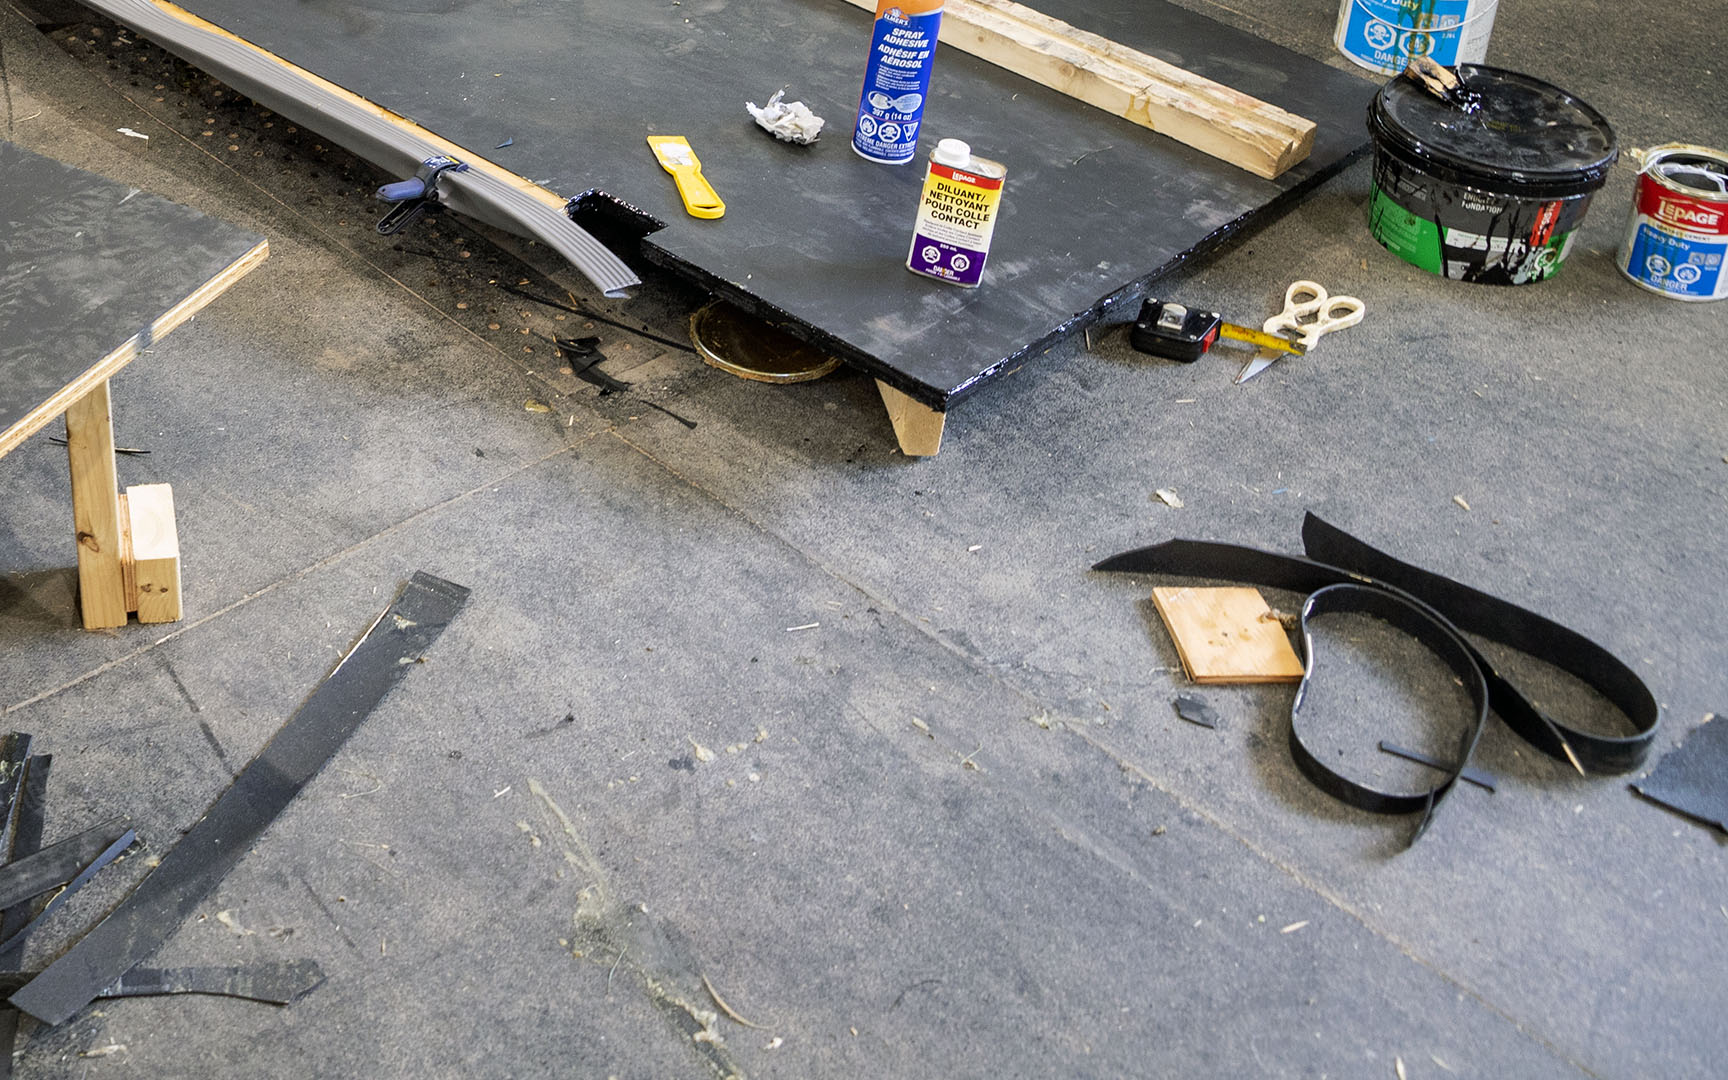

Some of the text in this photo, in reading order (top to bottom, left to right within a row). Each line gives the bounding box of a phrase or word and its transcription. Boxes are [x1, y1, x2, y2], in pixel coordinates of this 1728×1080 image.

[884, 13, 909, 26] ELMER'S
[883, 34, 929, 48] ADHESIVE
[892, 28, 925, 39] SPRAY
[878, 44, 930, 60] ADHÉSIF EN
[1374, 50, 1409, 67] DANGE
[880, 54, 923, 68] AÉROSOL
[875, 140, 898, 150] DANGER
[937, 182, 986, 202] DILUANT/
[930, 190, 990, 212] NETTOYANT
[925, 198, 990, 222] POUR COLLE
[1658, 200, 1719, 225] LEPAGE
[931, 210, 979, 230] CONTACT
[1669, 239, 1690, 251] Duty
[1651, 273, 1688, 291] DANGER
